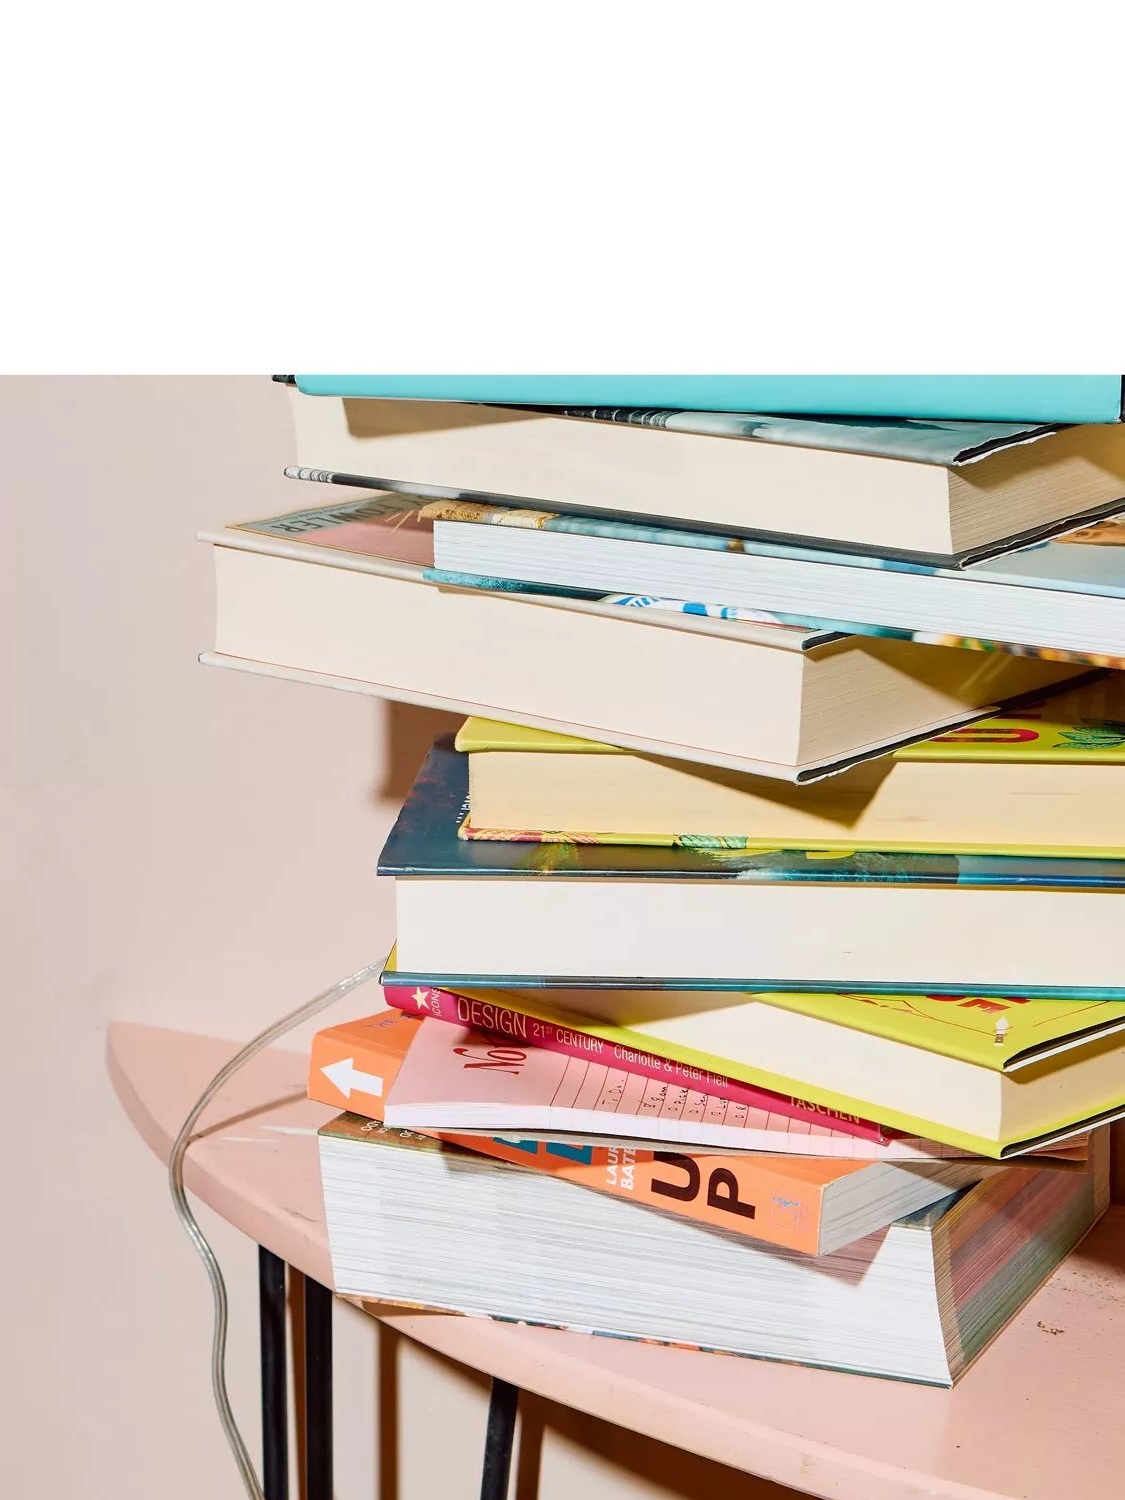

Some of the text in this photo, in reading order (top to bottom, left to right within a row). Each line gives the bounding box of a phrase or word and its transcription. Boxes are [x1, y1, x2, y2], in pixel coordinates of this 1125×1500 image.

[272, 503, 402, 534] FOWLER
[457, 997, 527, 1039] DESIGN
[556, 1029, 604, 1054] CENTURY
[663, 1059, 673, 1072] &
[675, 1063, 703, 1081] Peter
